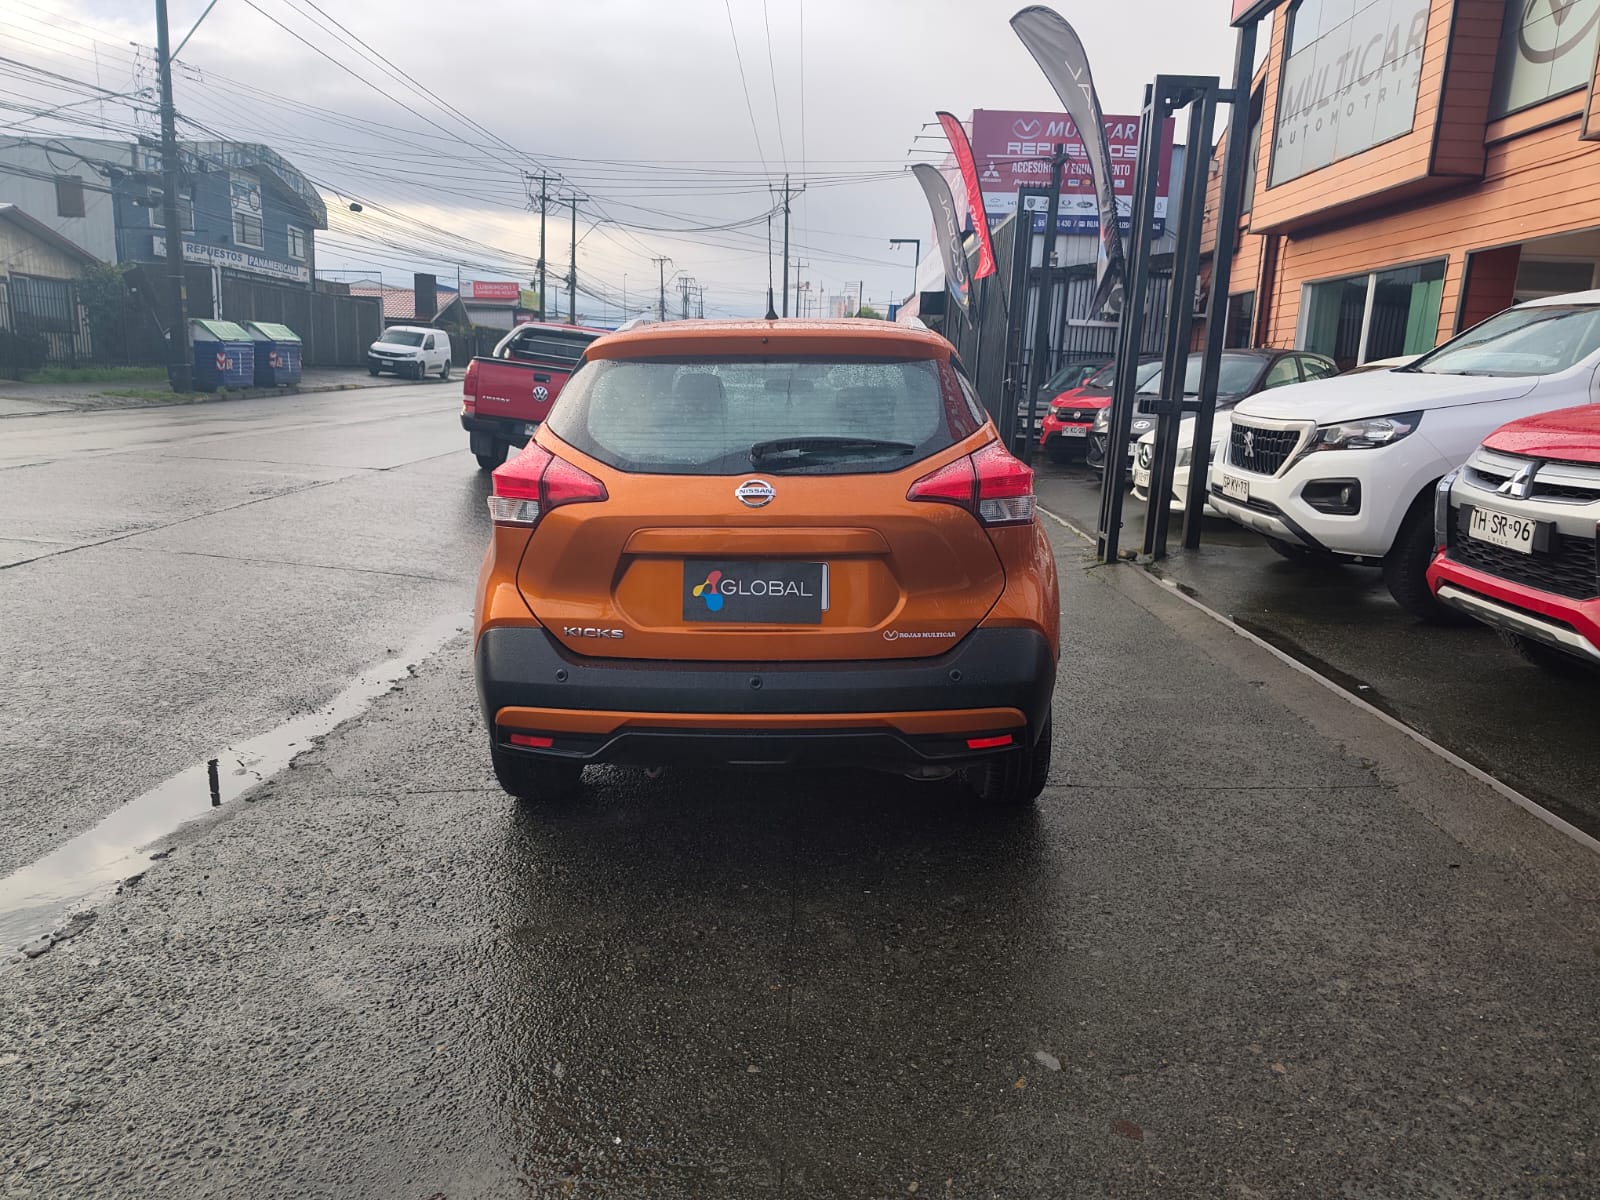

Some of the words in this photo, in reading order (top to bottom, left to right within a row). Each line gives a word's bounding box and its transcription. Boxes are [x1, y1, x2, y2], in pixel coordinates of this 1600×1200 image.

[1281, 8, 1430, 128] MULTICAR
[1277, 71, 1420, 149] AUTOMOTRIZ
[1046, 121, 1137, 140] MUCAR
[186, 243, 243, 263] REPUESTOS
[720, 579, 813, 597] GLOBAL
[563, 626, 625, 639] KICKS
